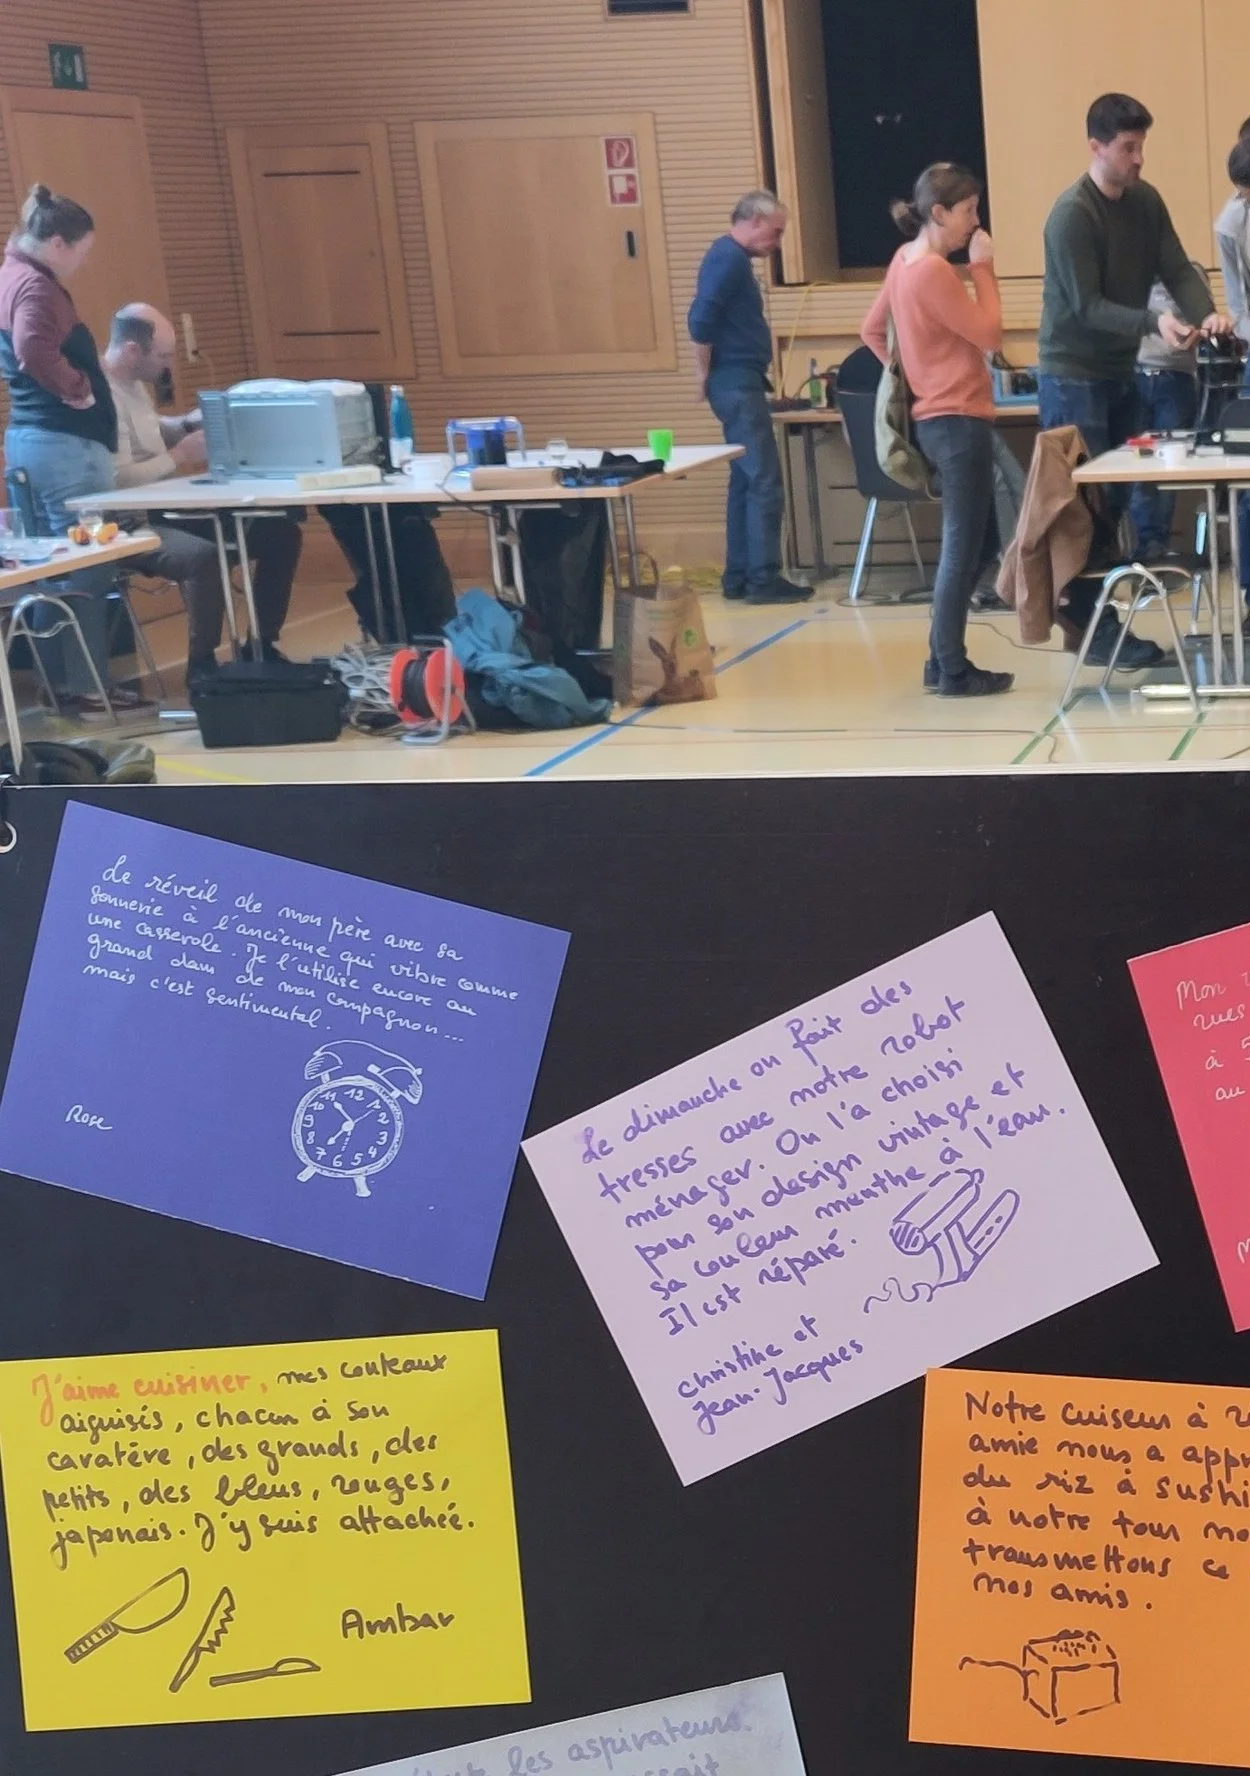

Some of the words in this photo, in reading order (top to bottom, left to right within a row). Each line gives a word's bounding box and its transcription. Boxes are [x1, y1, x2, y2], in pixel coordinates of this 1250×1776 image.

[102, 854, 132, 885] Le
[144, 873, 218, 903] réveil
[234, 892, 263, 913] de
[277, 906, 322, 927] mon
[328, 916, 372, 943] père
[383, 934, 424, 952] avec
[436, 942, 464, 961] sa
[87, 912, 122, 930] une
[245, 942, 267, 979] Je
[371, 982, 432, 1007] encore
[446, 999, 477, 1016] au
[87, 932, 153, 961] grand
[235, 962, 265, 987] de
[277, 981, 316, 998] mon
[182, 905, 199, 924] à
[337, 950, 374, 977] qui
[389, 960, 447, 987] vibre
[457, 977, 519, 1000] comme
[82, 964, 136, 985] mais
[149, 976, 195, 996] c'est
[1176, 978, 1227, 1010] Mon
[1193, 1003, 1245, 1031] rues
[581, 1126, 615, 1164] Le
[622, 1076, 743, 1143] dimanche
[749, 1055, 782, 1077] on
[785, 1014, 842, 1067] fait
[860, 980, 913, 1015] des
[1205, 1049, 1224, 1071] à
[343, 1088, 365, 1102] 12
[597, 1145, 698, 1204] tresses
[719, 1111, 775, 1144] avec
[789, 1064, 869, 1107] notre
[880, 995, 965, 1056] robot
[775, 1128, 822, 1156] On
[881, 1047, 964, 1103] choisi
[1215, 1086, 1246, 1101] au
[65, 1104, 113, 1131] Rose
[377, 1111, 390, 1125] 2
[306, 1130, 316, 1145] 8
[315, 1146, 327, 1161] 7
[375, 1130, 389, 1146] 3
[332, 1154, 343, 1168] 6
[350, 1152, 364, 1167] 5
[634, 1232, 696, 1280] pour
[706, 1207, 755, 1236] son
[760, 1153, 862, 1208] design
[877, 1095, 981, 1153] vintage
[990, 1062, 1025, 1097] et
[649, 1278, 688, 1302] sa
[814, 1165, 927, 1220] menthe
[939, 1136, 964, 1165] à
[658, 1302, 699, 1336] Il
[702, 1282, 742, 1316] est
[793, 1314, 819, 1342] et
[276, 1366, 329, 1385] mes
[195, 1401, 300, 1429] chacun
[311, 1398, 332, 1422] à
[346, 1400, 390, 1422] son
[964, 1390, 1047, 1425] Notre
[1186, 1401, 1209, 1429] à
[201, 1435, 249, 1463] des
[384, 1425, 438, 1456] des
[968, 1430, 1039, 1456] amie
[1056, 1440, 1132, 1465] nous
[1145, 1444, 1166, 1463] a
[138, 1477, 191, 1506] des
[962, 1463, 1012, 1488] du
[1035, 1469, 1095, 1495] riz
[1116, 1467, 1137, 1496] à
[258, 1509, 318, 1538] suis
[965, 1495, 992, 1526] à
[1008, 1502, 1091, 1531] notre
[961, 1537, 1172, 1578] transmettons
[1202, 1558, 1230, 1580] ce
[972, 1571, 1033, 1598] nos
